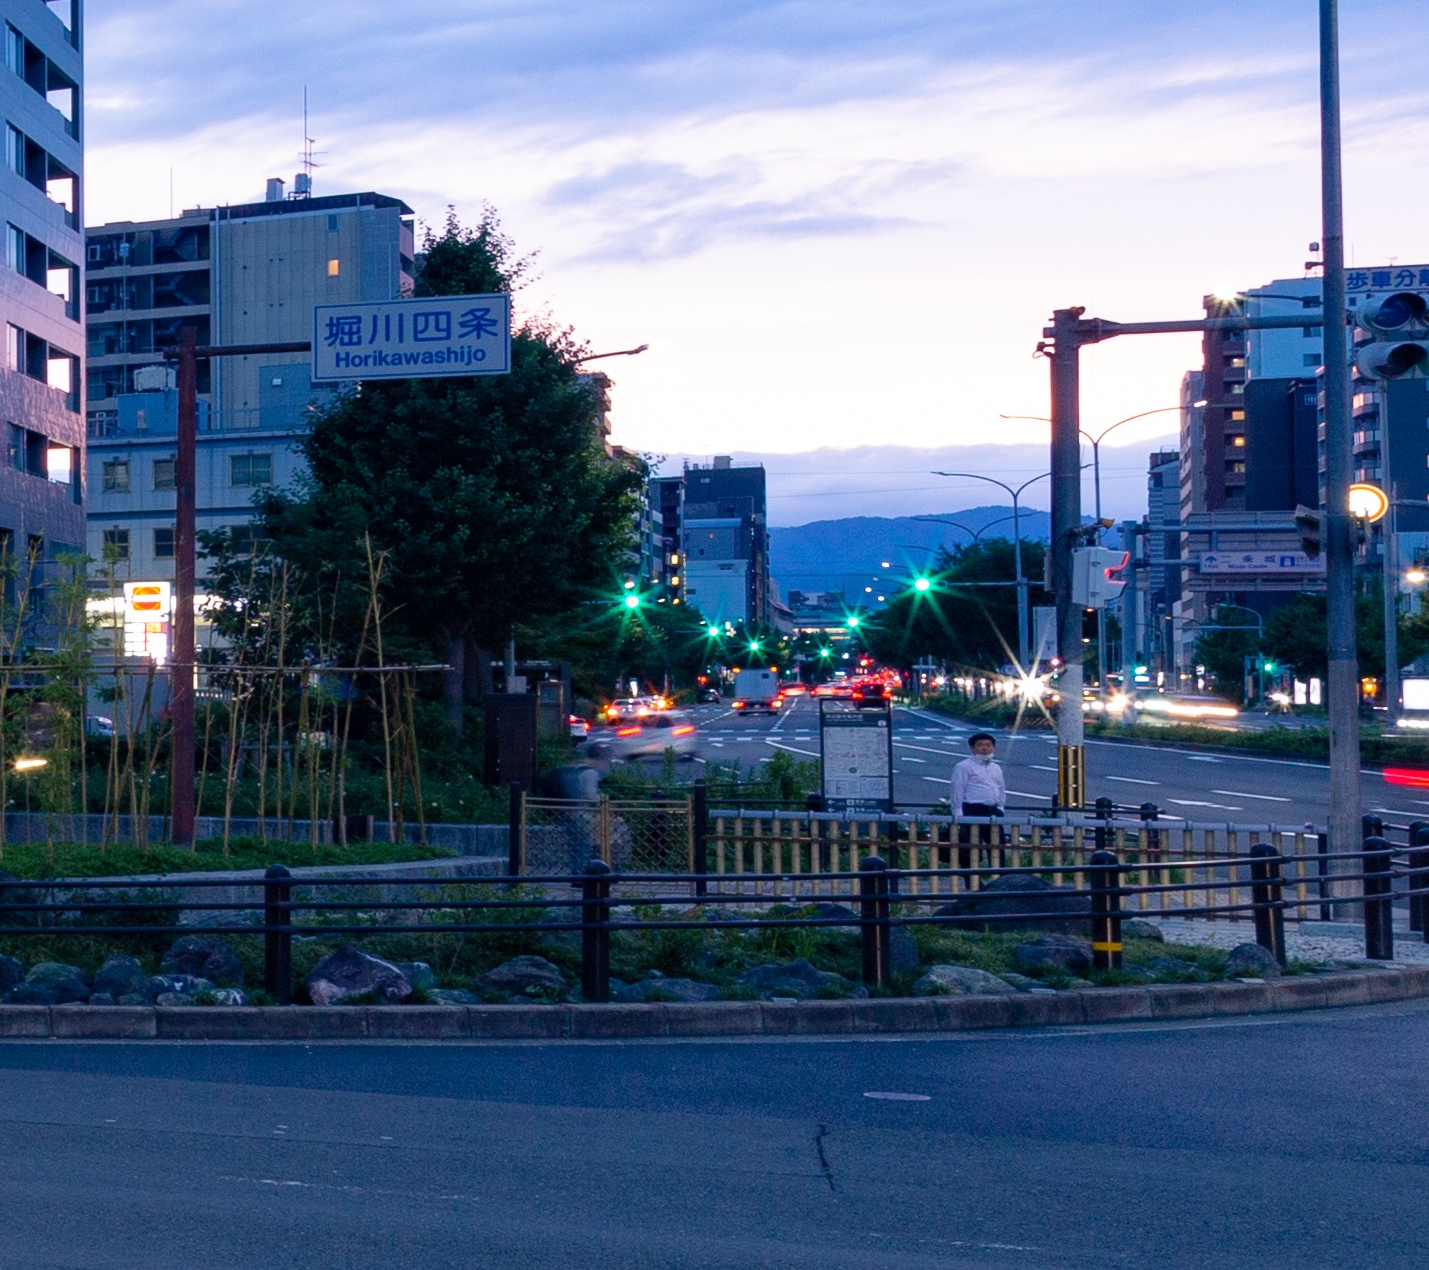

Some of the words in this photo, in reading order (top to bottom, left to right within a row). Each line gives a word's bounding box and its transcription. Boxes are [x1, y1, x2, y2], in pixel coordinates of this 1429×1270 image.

[324, 307, 499, 347] 堀川四条
[335, 345, 487, 368] Horikawashijo
